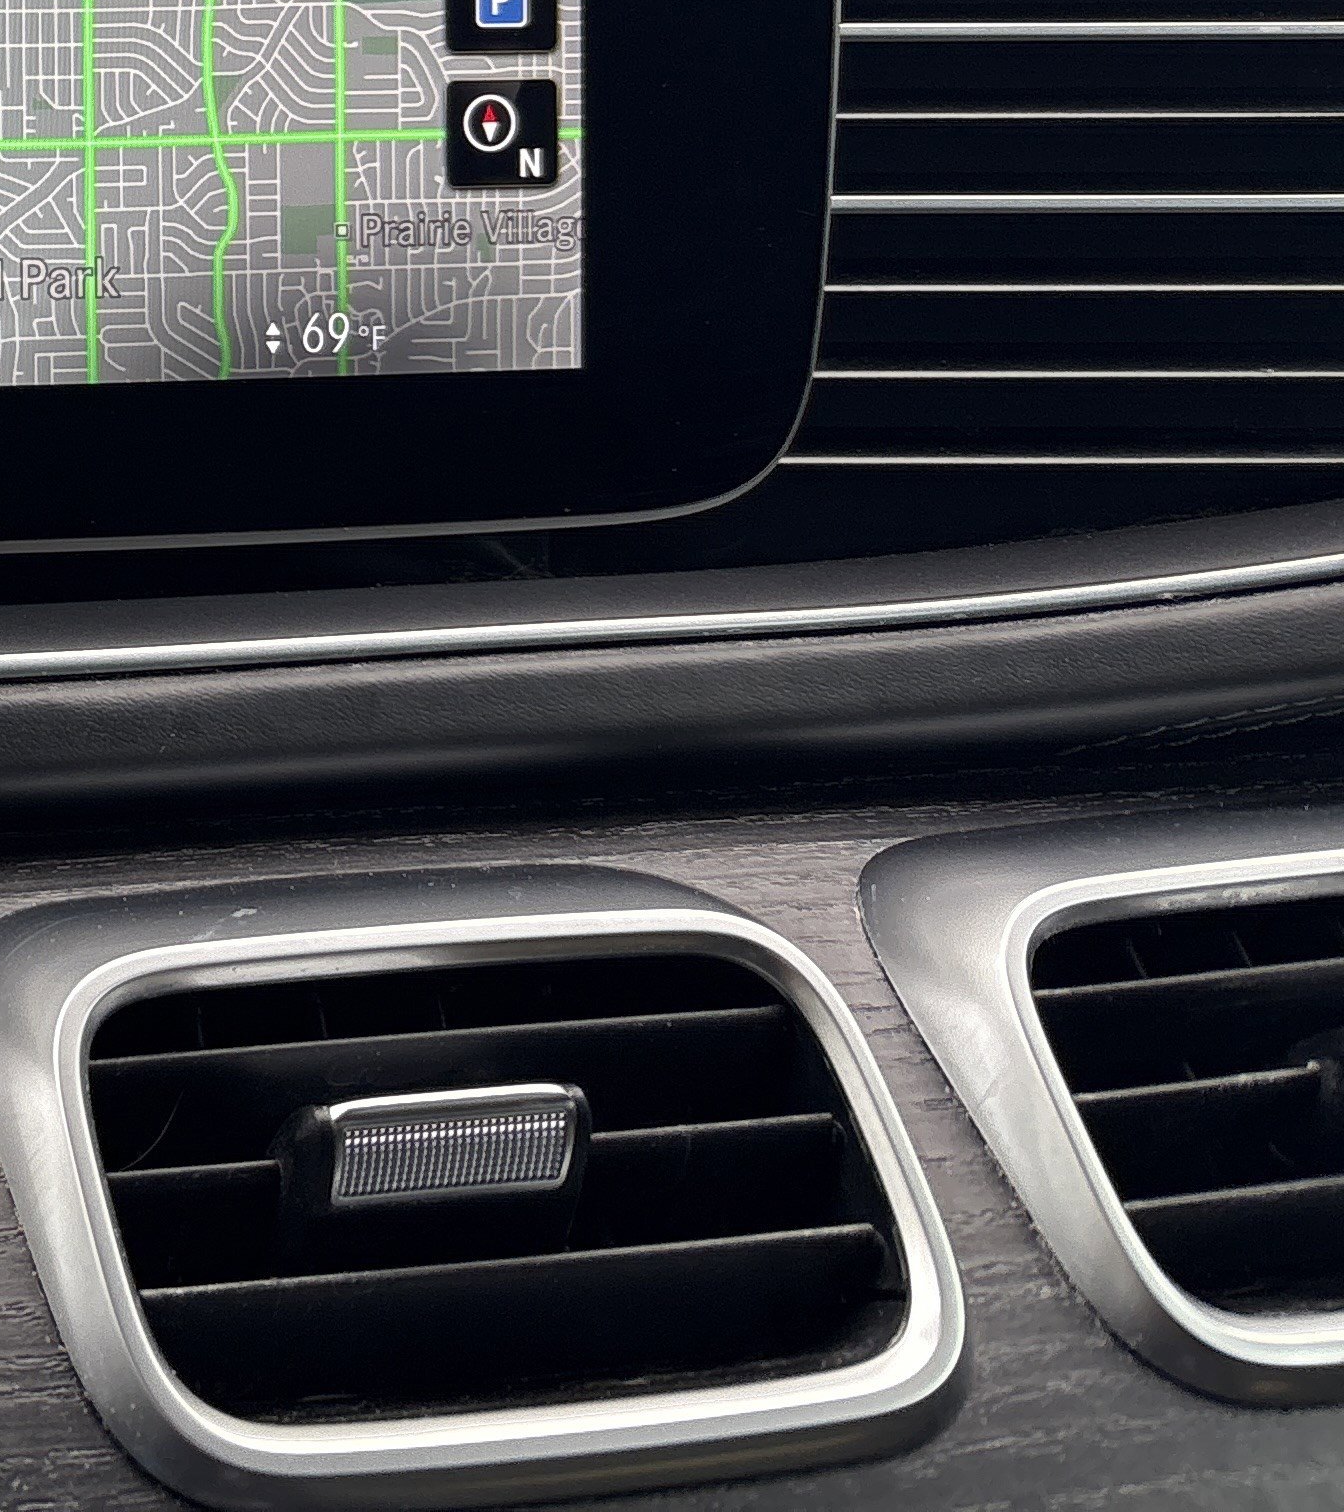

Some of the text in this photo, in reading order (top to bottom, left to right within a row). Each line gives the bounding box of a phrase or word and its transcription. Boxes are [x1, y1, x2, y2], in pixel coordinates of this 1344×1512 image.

[518, 147, 542, 179] N
[361, 208, 582, 252] Prairie Villag
[19, 256, 121, 301] Park
